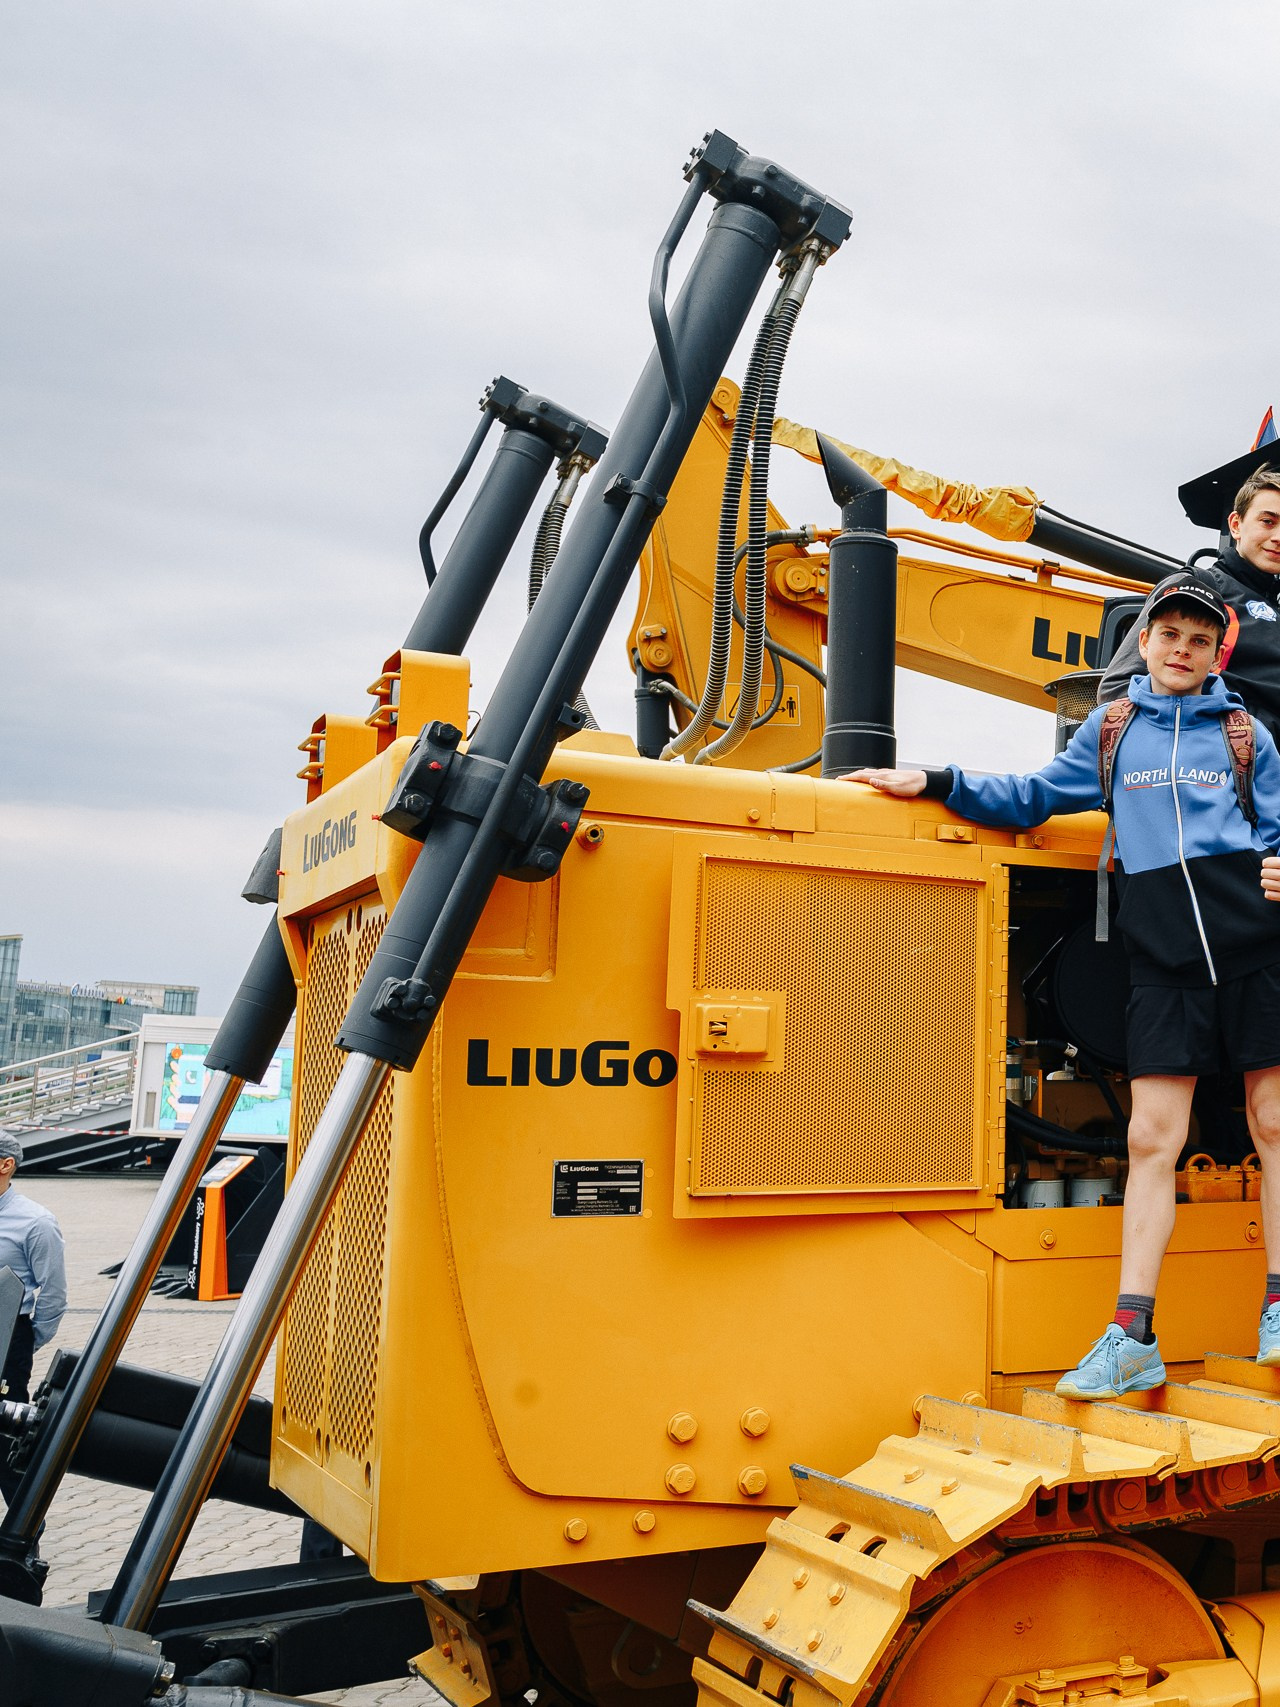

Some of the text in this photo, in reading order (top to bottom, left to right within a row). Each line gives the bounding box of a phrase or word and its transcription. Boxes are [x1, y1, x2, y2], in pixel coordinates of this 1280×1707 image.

[1178, 585, 1214, 600] HINO
[1123, 766, 1218, 785] NORTH LAND
